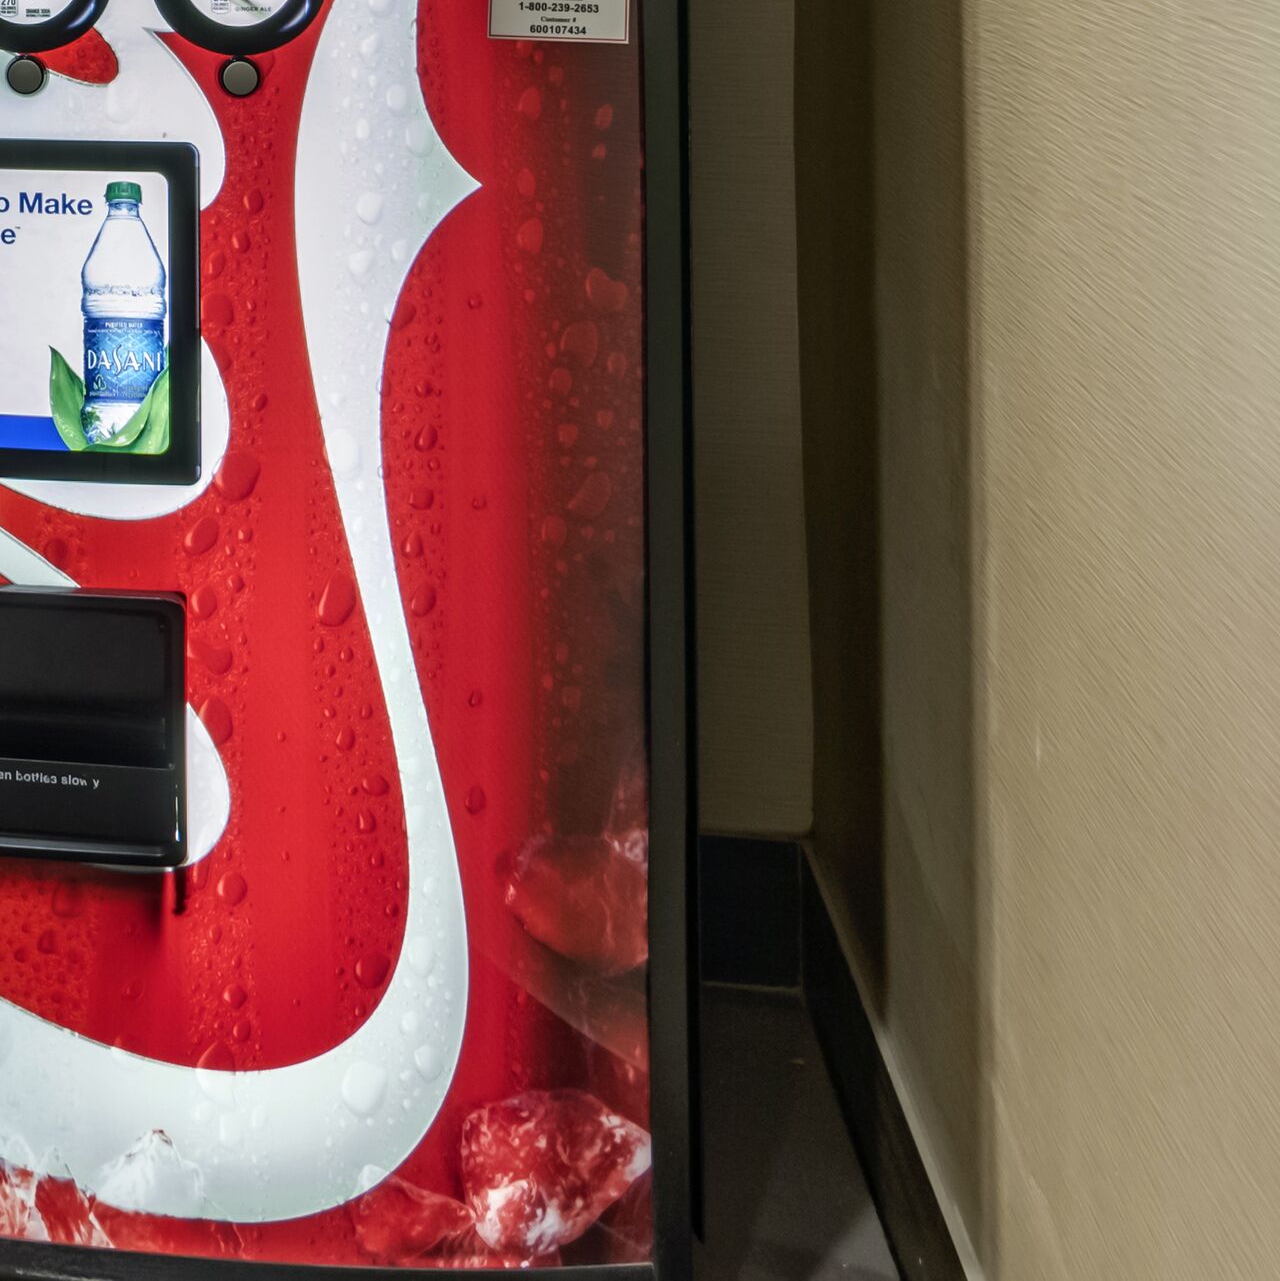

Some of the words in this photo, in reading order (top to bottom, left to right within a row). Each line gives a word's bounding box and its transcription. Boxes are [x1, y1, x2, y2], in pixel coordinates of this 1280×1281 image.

[518, 1, 599, 13] 1-800-239-2653
[529, 24, 587, 35] 600107434
[19, 193, 93, 216] Make
[88, 344, 161, 376] DASANI
[16, 770, 57, 784] bottles
